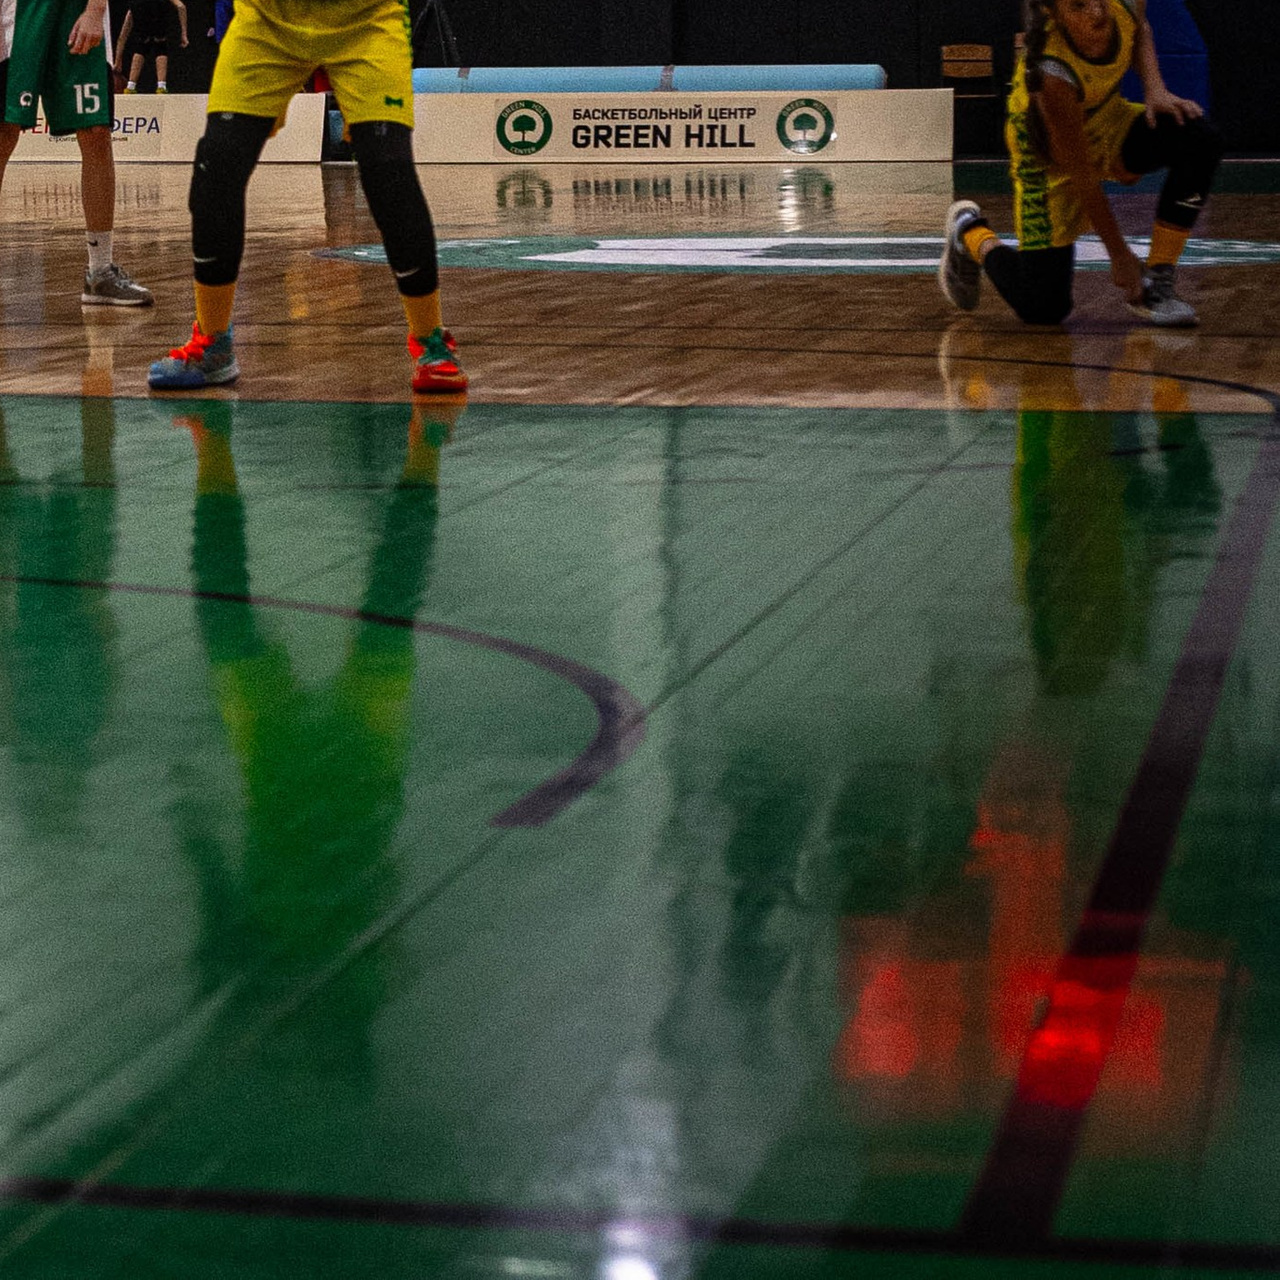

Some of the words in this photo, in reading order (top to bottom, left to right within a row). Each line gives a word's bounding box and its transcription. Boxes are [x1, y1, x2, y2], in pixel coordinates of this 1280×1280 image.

[73, 82, 101, 115] 15
[573, 104, 703, 121] БАСКЕТБОЛЬНЫЙ
[708, 106, 757, 122] ЦЕНТР
[572, 124, 671, 149] GREEN
[685, 123, 756, 148] HILL
